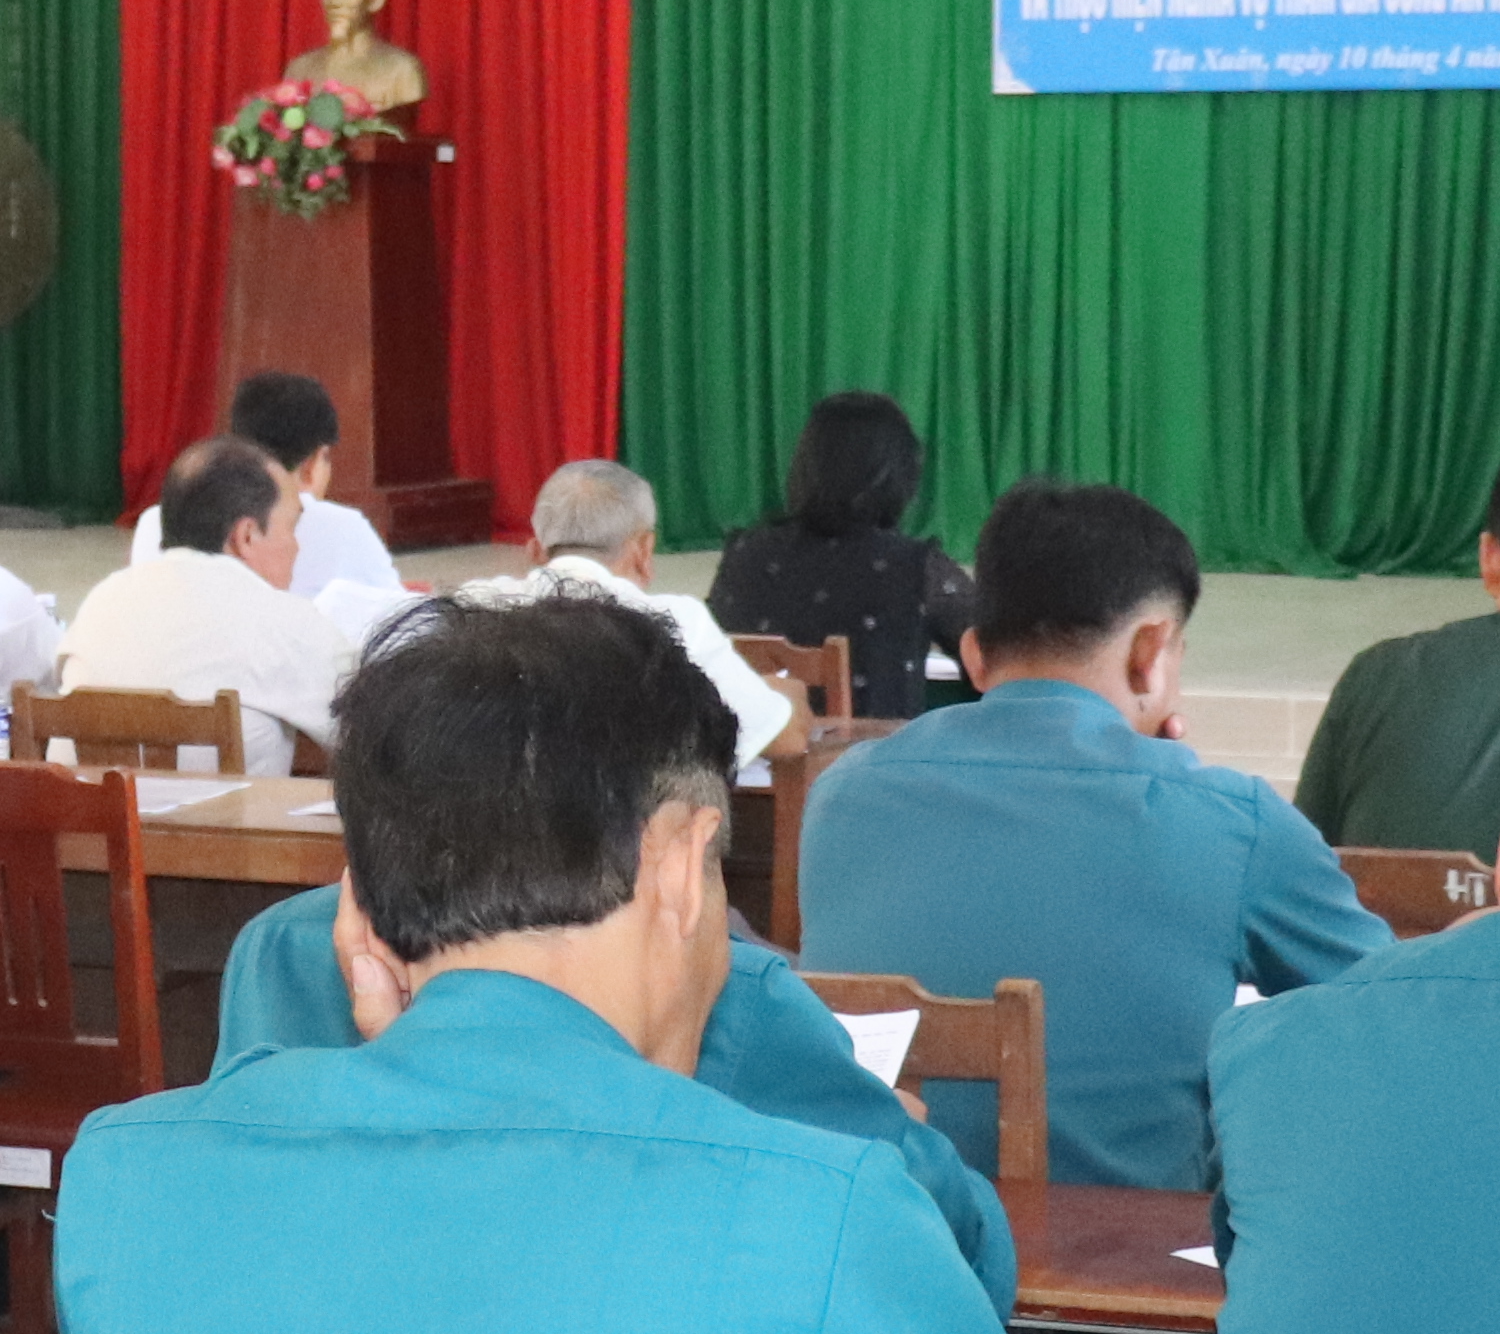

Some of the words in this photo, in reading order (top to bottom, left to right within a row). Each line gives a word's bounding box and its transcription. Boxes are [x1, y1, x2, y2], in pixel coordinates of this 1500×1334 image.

[1152, 48, 1198, 72] Tân
[1275, 48, 1333, 76] ngày
[1339, 47, 1366, 69] 10
[1372, 46, 1440, 76] tháng
[1445, 47, 1461, 68] 4
[1443, 869, 1490, 907] HT
